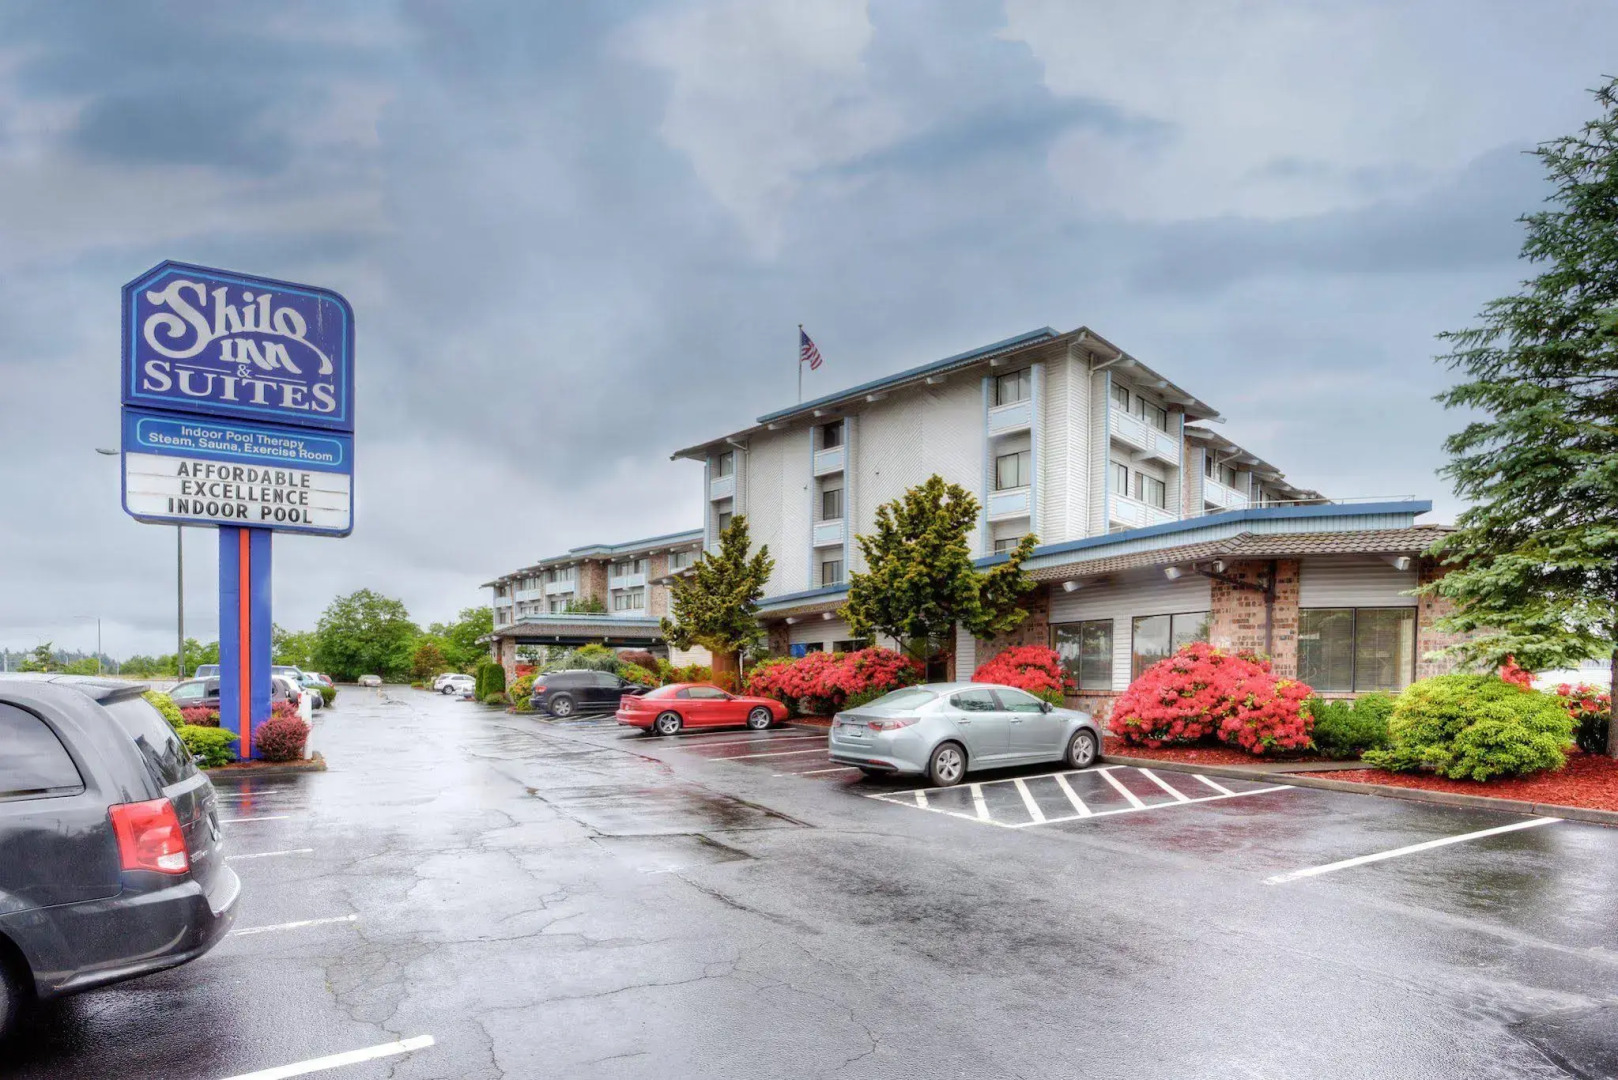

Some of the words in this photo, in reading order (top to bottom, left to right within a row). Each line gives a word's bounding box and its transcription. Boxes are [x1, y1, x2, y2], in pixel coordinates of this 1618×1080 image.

[144, 280, 333, 375] Shilo
[236, 364, 251, 378] &
[143, 360, 336, 413] SUITES
[149, 432, 195, 447] Steam,
[199, 438, 241, 453] Sauna,
[244, 443, 296, 458] Exercise
[299, 449, 333, 461] Room
[181, 426, 222, 439] Indoor
[226, 431, 253, 443] Pool
[256, 434, 304, 450] Therapy
[177, 461, 311, 489] AFFORDABLE
[181, 479, 308, 506] EXCELLENCE
[168, 497, 248, 519] INDOOR
[261, 506, 313, 524] POOL
